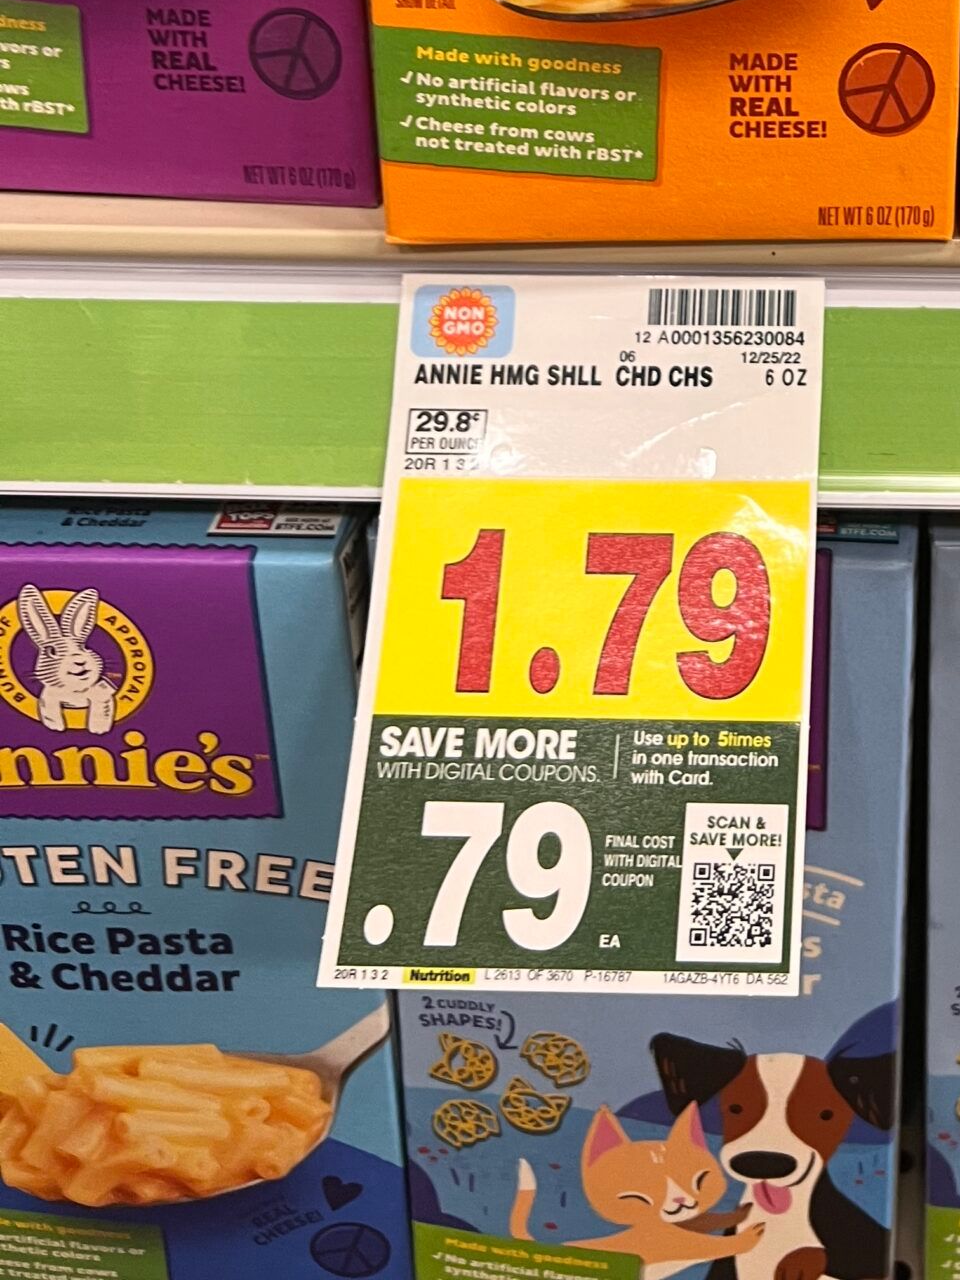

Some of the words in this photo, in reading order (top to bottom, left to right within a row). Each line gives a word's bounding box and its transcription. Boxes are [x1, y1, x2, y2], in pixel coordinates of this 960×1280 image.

[444, 307, 485, 321] NON
[443, 322, 486, 336] GMO
[635, 332, 651, 343] 12
[658, 330, 805, 346] A0001356230084
[620, 351, 636, 362] 06
[741, 352, 801, 364] 12/25/22
[414, 364, 483, 385] ANNIE
[490, 364, 540, 386] HMG
[547, 364, 602, 386] SHLL
[616, 365, 661, 387] CHD
[669, 366, 714, 387] CHS
[765, 368, 774, 386] 6
[410, 437, 435, 449] PER
[441, 528, 771, 701] 1.79
[379, 726, 464, 759] SAVE
[473, 728, 578, 760] MORE
[633, 730, 664, 746] Use
[667, 732, 689, 749] up
[692, 732, 710, 747] to
[632, 751, 648, 764] in
[651, 753, 684, 766] one
[688, 752, 779, 767] transaction
[377, 761, 423, 779] WITH
[425, 763, 496, 781] DIGITAL
[499, 764, 601, 784] COUPONS.
[631, 770, 665, 784] with
[668, 770, 713, 786] Card.
[708, 816, 750, 829] SCAN
[756, 817, 766, 829] &
[605, 835, 640, 848] FINAL
[642, 835, 676, 848] COST
[690, 833, 726, 846] SAVE
[732, 834, 782, 846] MORE!
[604, 854, 636, 867] WITH
[637, 854, 683, 868] DIGITAL
[163, 846, 336, 904] FREE
[363, 800, 593, 951] .79
[602, 873, 654, 887] COUPON
[2, 923, 96, 953] Rice
[106, 927, 235, 956] Pasta
[599, 935, 621, 948] EA
[9, 965, 44, 991] &
[51, 963, 241, 993] Cheddar
[334, 969, 357, 979] 20R
[410, 970, 470, 981] Nutrition
[767, 974, 788, 985] 562
